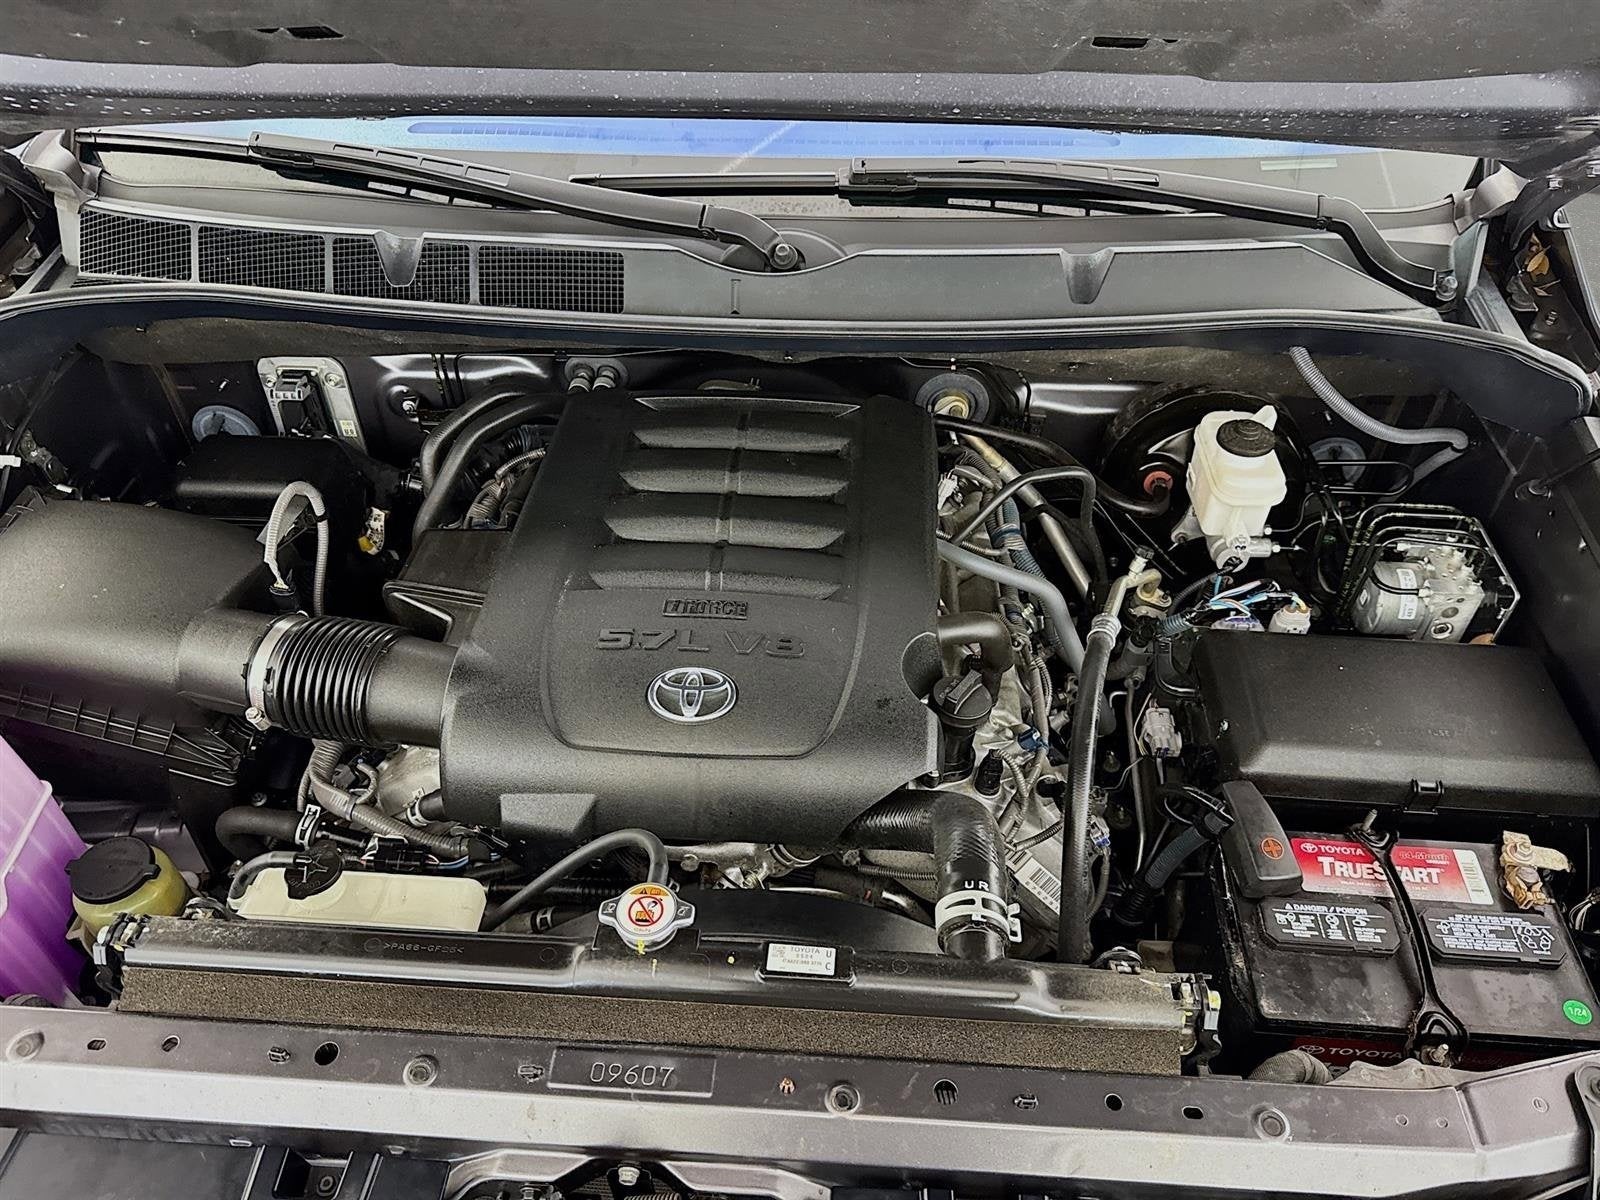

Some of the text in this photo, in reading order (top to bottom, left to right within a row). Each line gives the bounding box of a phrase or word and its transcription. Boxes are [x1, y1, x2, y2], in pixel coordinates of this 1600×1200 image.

[724, 629, 805, 657] V8
[1318, 844, 1366, 857] TOYOTA
[791, 946, 820, 954] TOYOTA
[1329, 1047, 1402, 1059] TOYOTA
[589, 1062, 675, 1087] 09607
